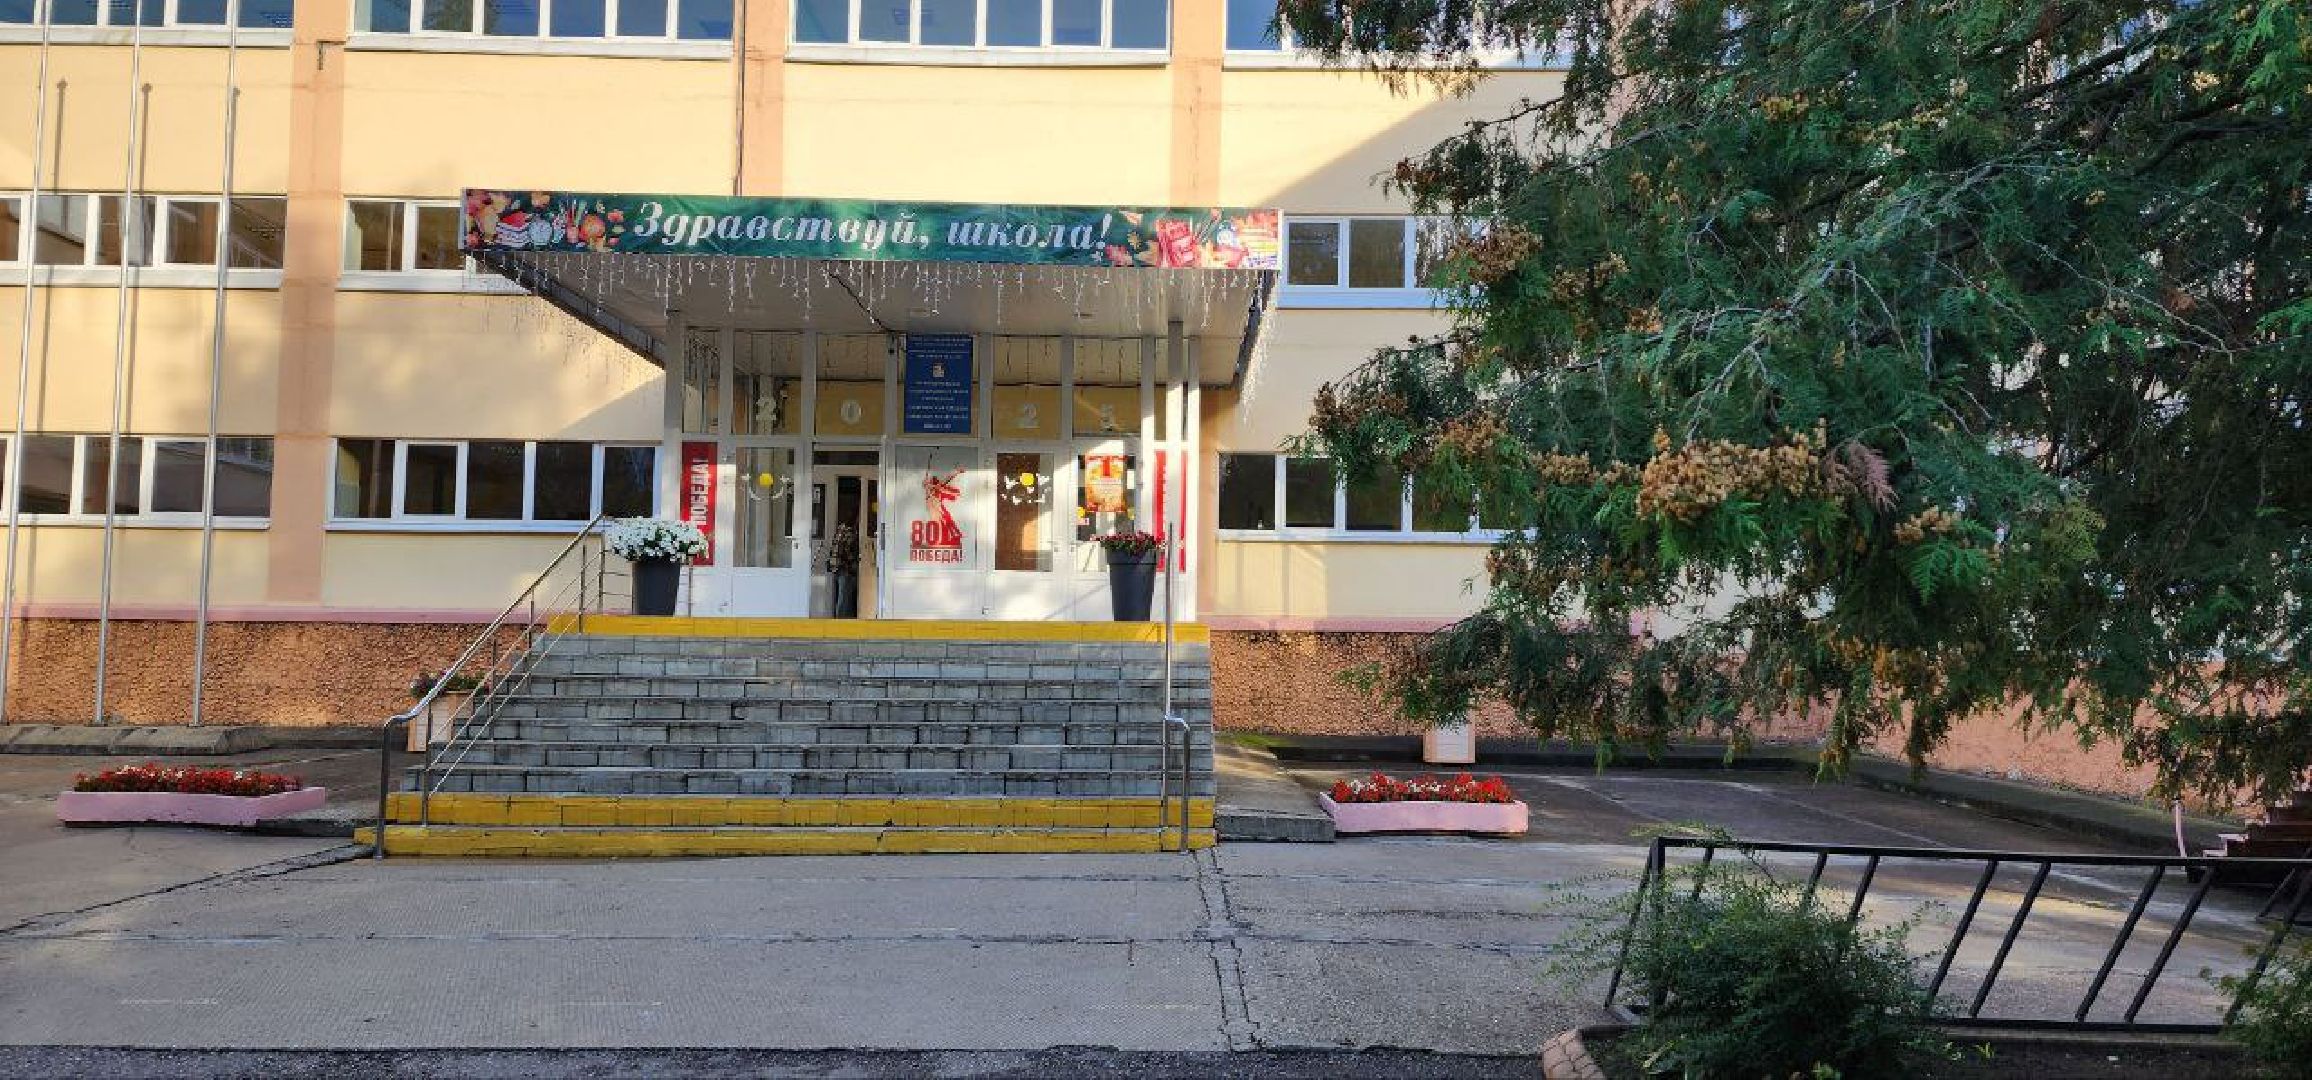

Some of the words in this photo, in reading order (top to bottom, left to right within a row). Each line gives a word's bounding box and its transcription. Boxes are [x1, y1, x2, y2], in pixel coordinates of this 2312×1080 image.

[634, 200, 930, 251] Здравствуй,
[946, 212, 1112, 251] школа!
[691, 457, 711, 526] ПОБЕДА!
[911, 520, 940, 549] 80
[909, 549, 963, 564] ПОБЕДА!
